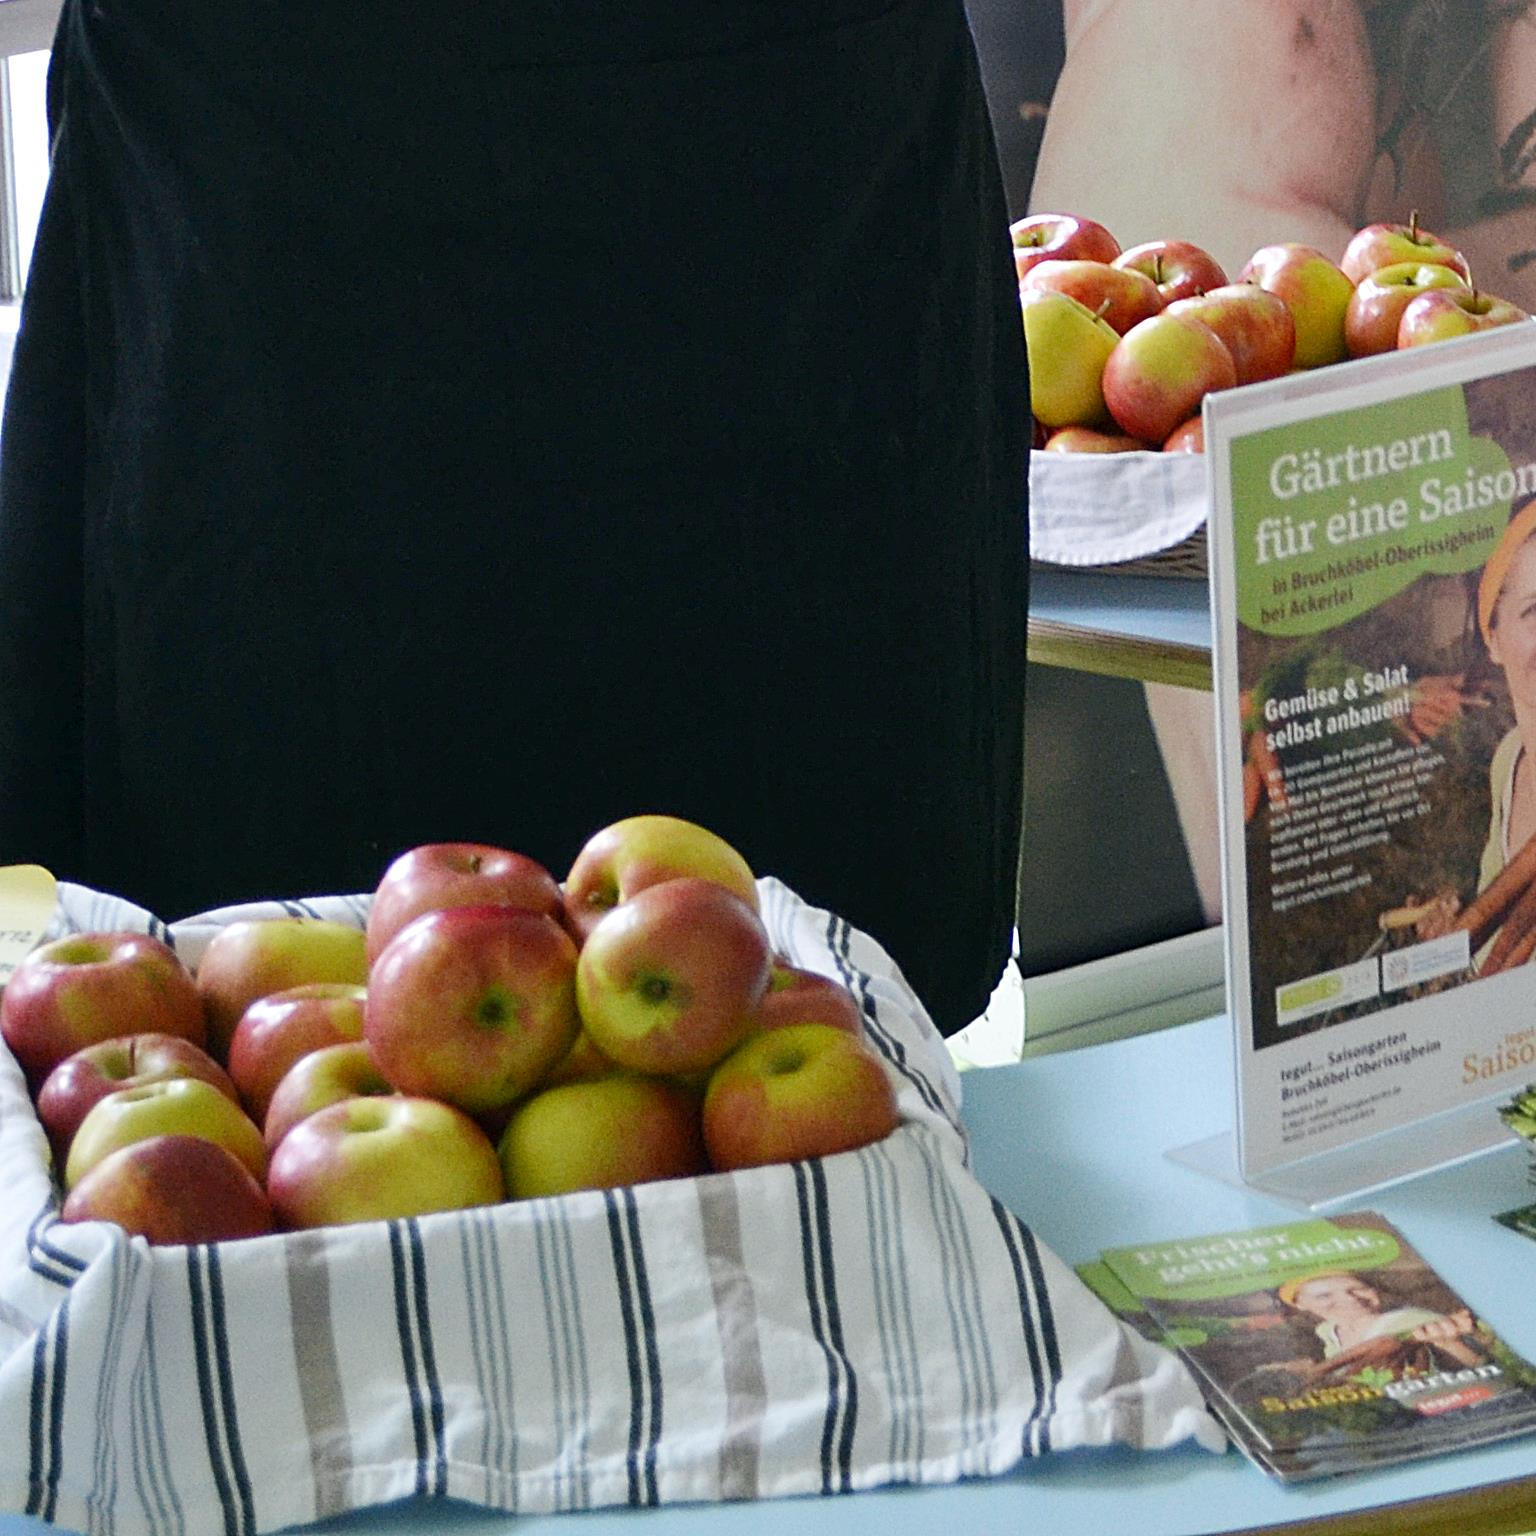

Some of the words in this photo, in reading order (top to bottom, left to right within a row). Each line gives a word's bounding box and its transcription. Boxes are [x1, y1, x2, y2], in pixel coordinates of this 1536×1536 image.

[1270, 429, 1454, 500] Gärtnern
[1255, 516, 1316, 565] für
[1326, 497, 1408, 545] eine
[1290, 523, 1495, 590] Bruchköbel-Oberissigheim
[1260, 607, 1284, 625] bei
[1288, 588, 1354, 617] Ackerlei
[1264, 685, 1338, 722] Gemüse
[1343, 677, 1359, 701] &
[1363, 664, 1409, 695] Salat
[1266, 717, 1323, 752] selbst
[1326, 693, 1410, 735] anbauen!
[1281, 1039, 1441, 1101] Bruchköbel-Oberissigheim
[1327, 1032, 1407, 1065] Saisongarten
[1136, 1234, 1289, 1265] Frischer
[1161, 1252, 1270, 1282] geht's
[1277, 1234, 1387, 1261] nicht.
[1262, 1365, 1502, 1412] Saisongarten
